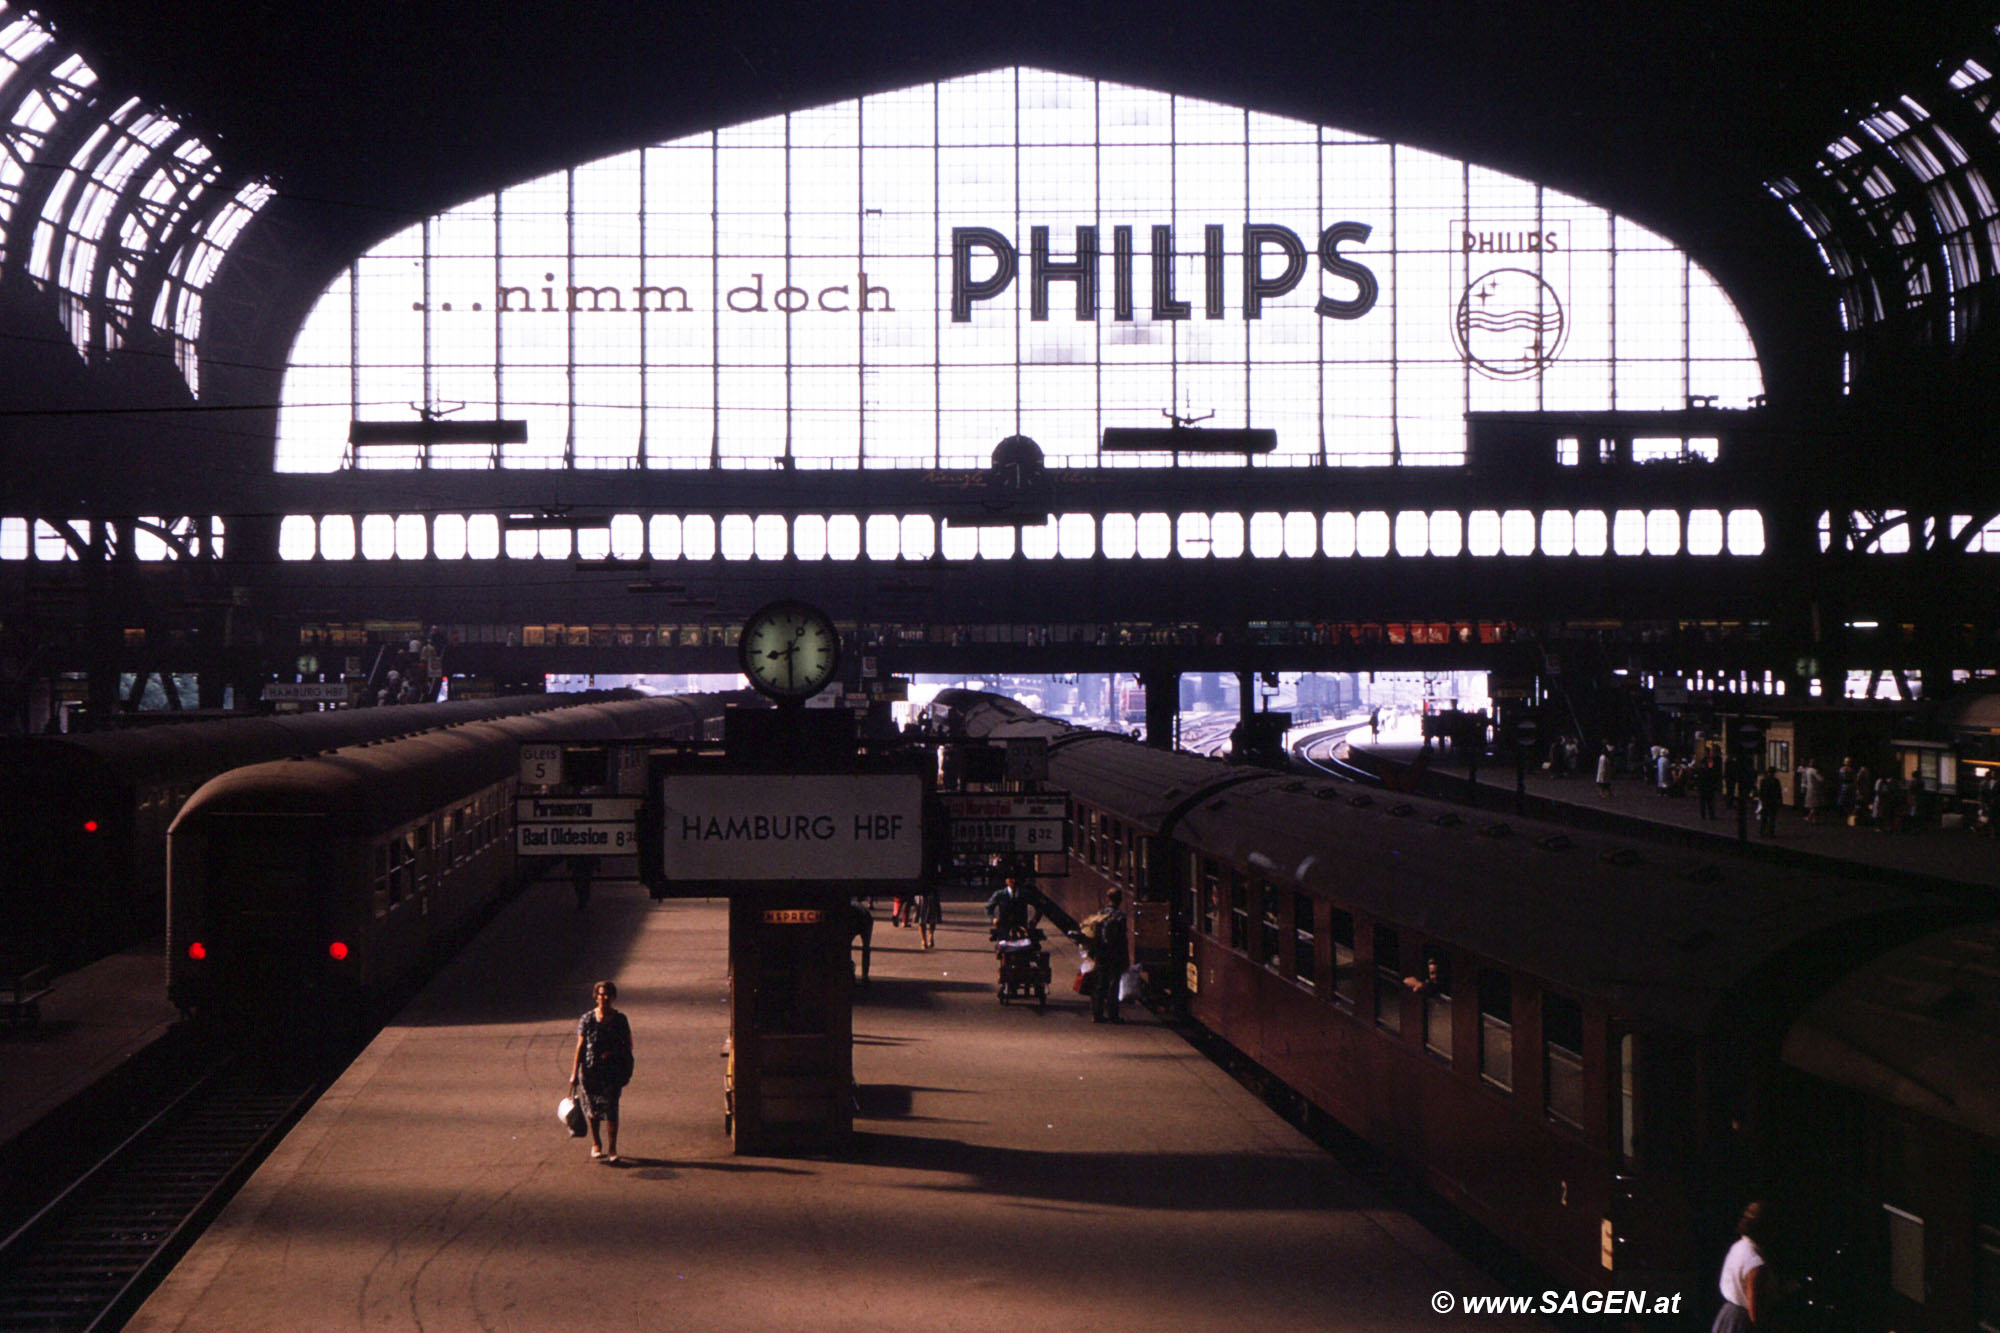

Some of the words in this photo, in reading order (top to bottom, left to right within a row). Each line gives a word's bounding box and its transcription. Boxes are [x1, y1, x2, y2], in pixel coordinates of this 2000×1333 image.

[1462, 230, 1558, 254] PHILIPS
[726, 272, 896, 313] doch
[951, 221, 1379, 323] PHILIPS
[269, 686, 321, 698] HAMBURG
[523, 750, 557, 760] GLEIS
[535, 763, 546, 778] 5
[523, 827, 548, 846] Bad
[551, 827, 608, 846] Oldesloe
[682, 814, 835, 841] HAMBURG
[854, 814, 904, 841] HBF
